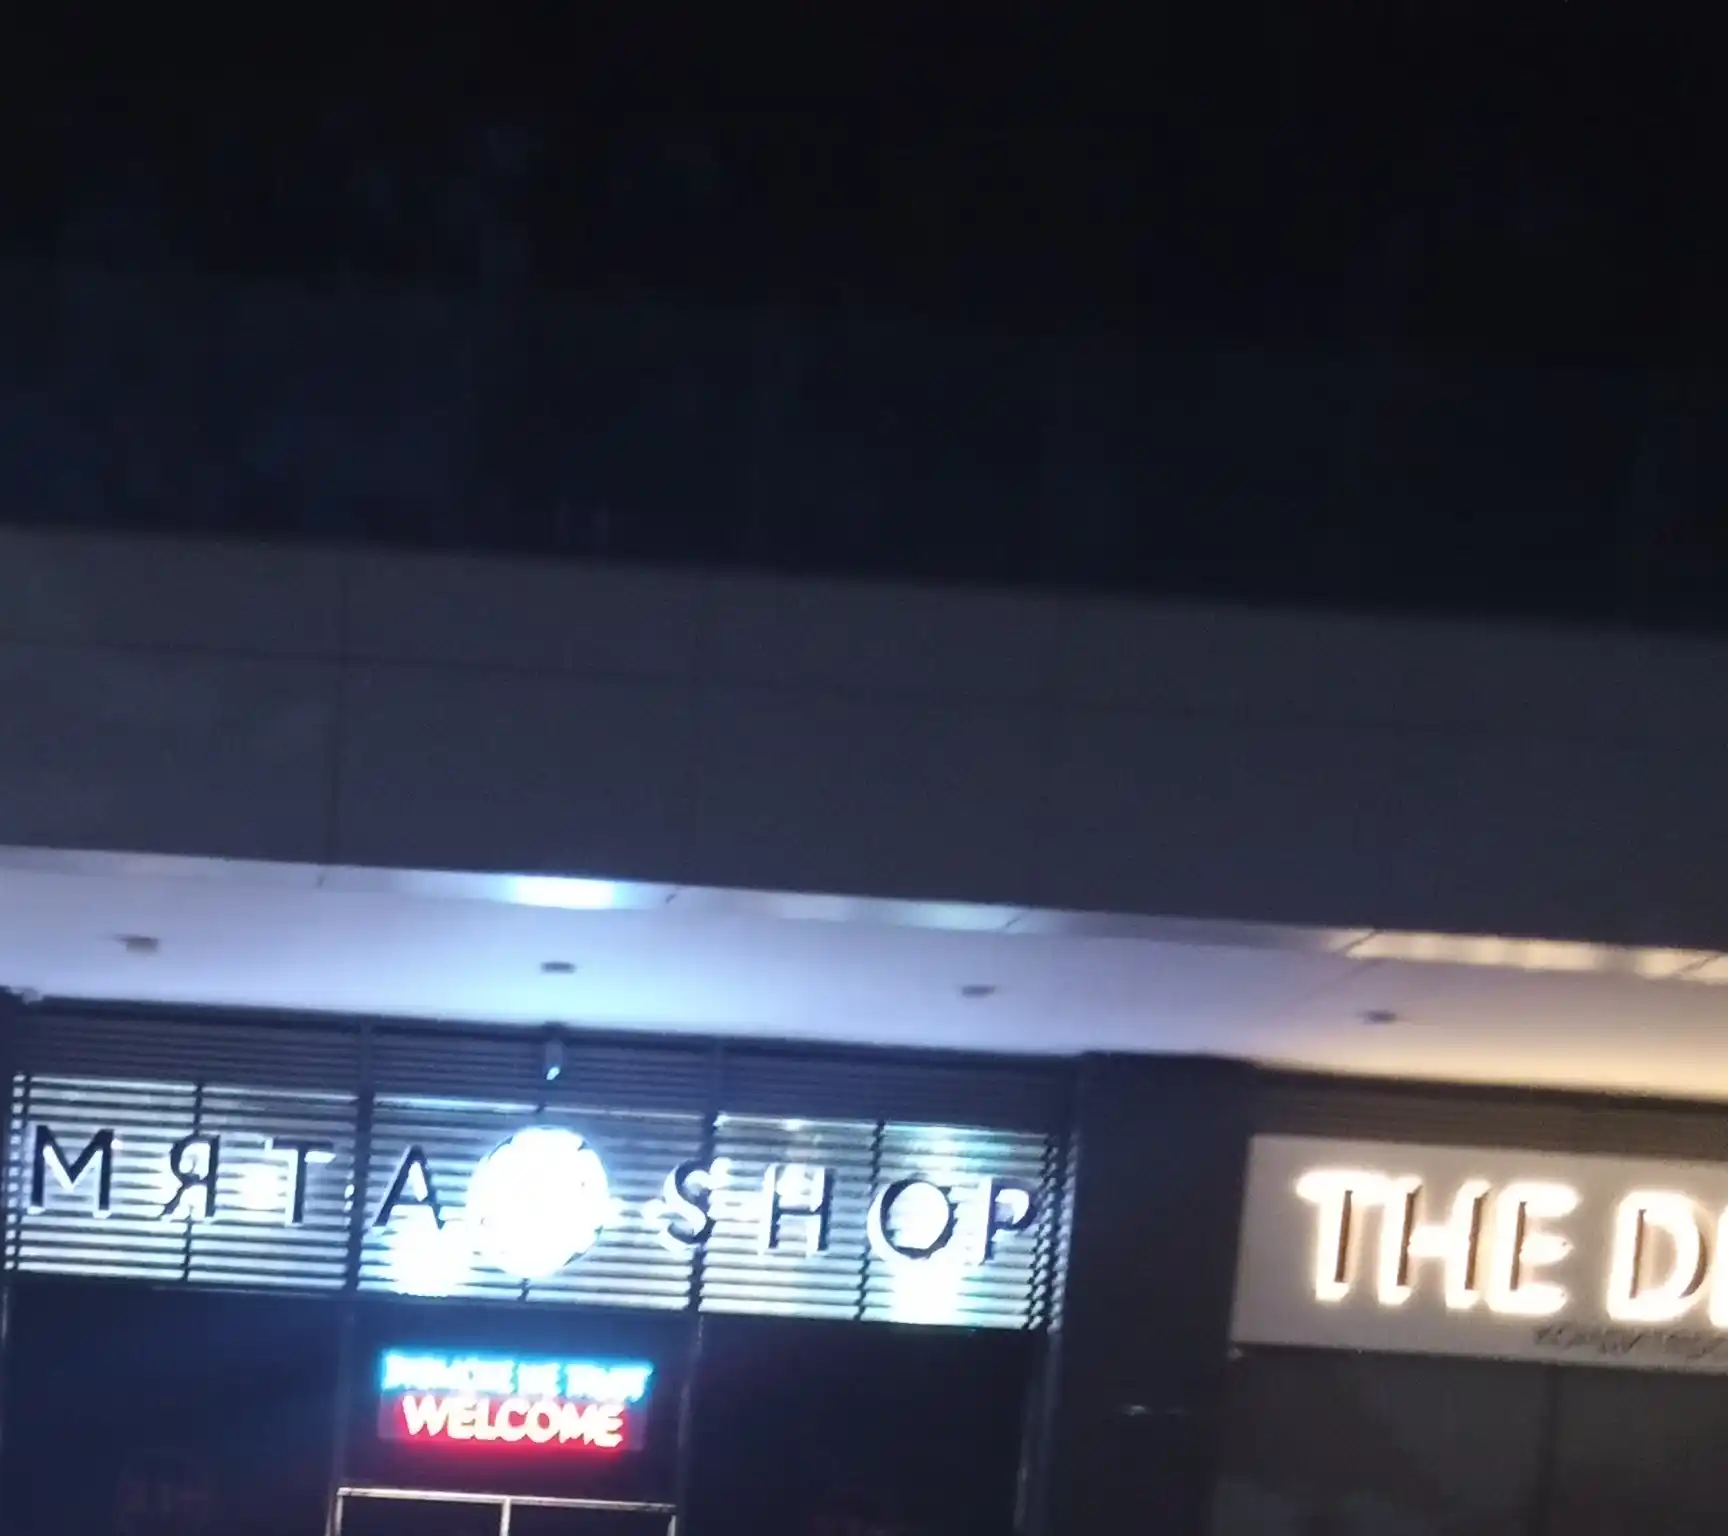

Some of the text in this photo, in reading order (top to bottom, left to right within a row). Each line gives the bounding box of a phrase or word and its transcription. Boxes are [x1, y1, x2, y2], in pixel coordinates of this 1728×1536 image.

[28, 1122, 1040, 1266] МЯТА SHOP
[1297, 1167, 1728, 1327] THE D
[401, 1395, 624, 1448] WELCOME
